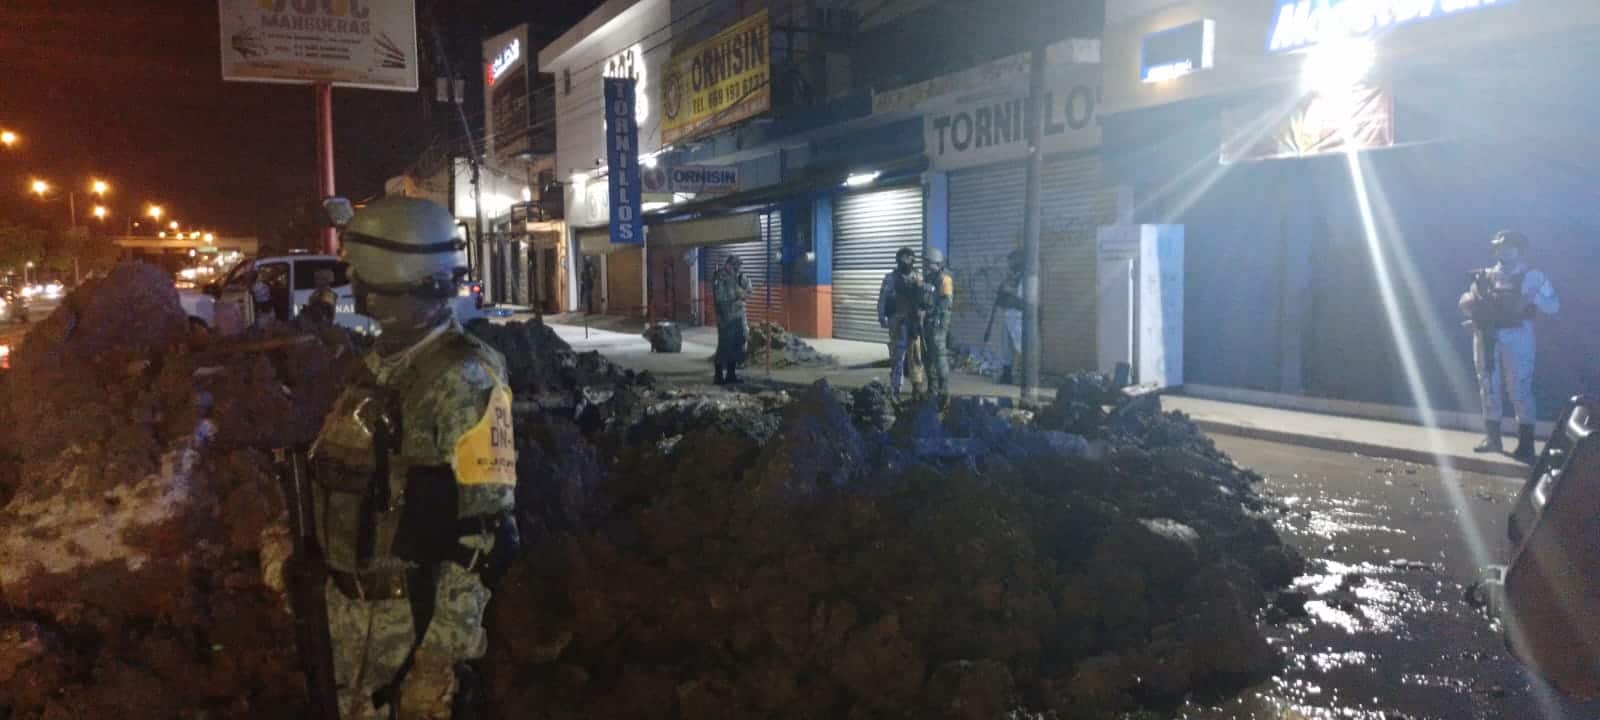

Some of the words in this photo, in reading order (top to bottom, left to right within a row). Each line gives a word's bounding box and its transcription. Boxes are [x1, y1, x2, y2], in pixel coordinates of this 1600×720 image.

[261, 15, 370, 34] MANGUERAS
[691, 25, 765, 92] ORNISIN
[933, 85, 1104, 156] TORNILO
[613, 82, 634, 239] TORNILLOS
[673, 169, 736, 184] ORNISIN
